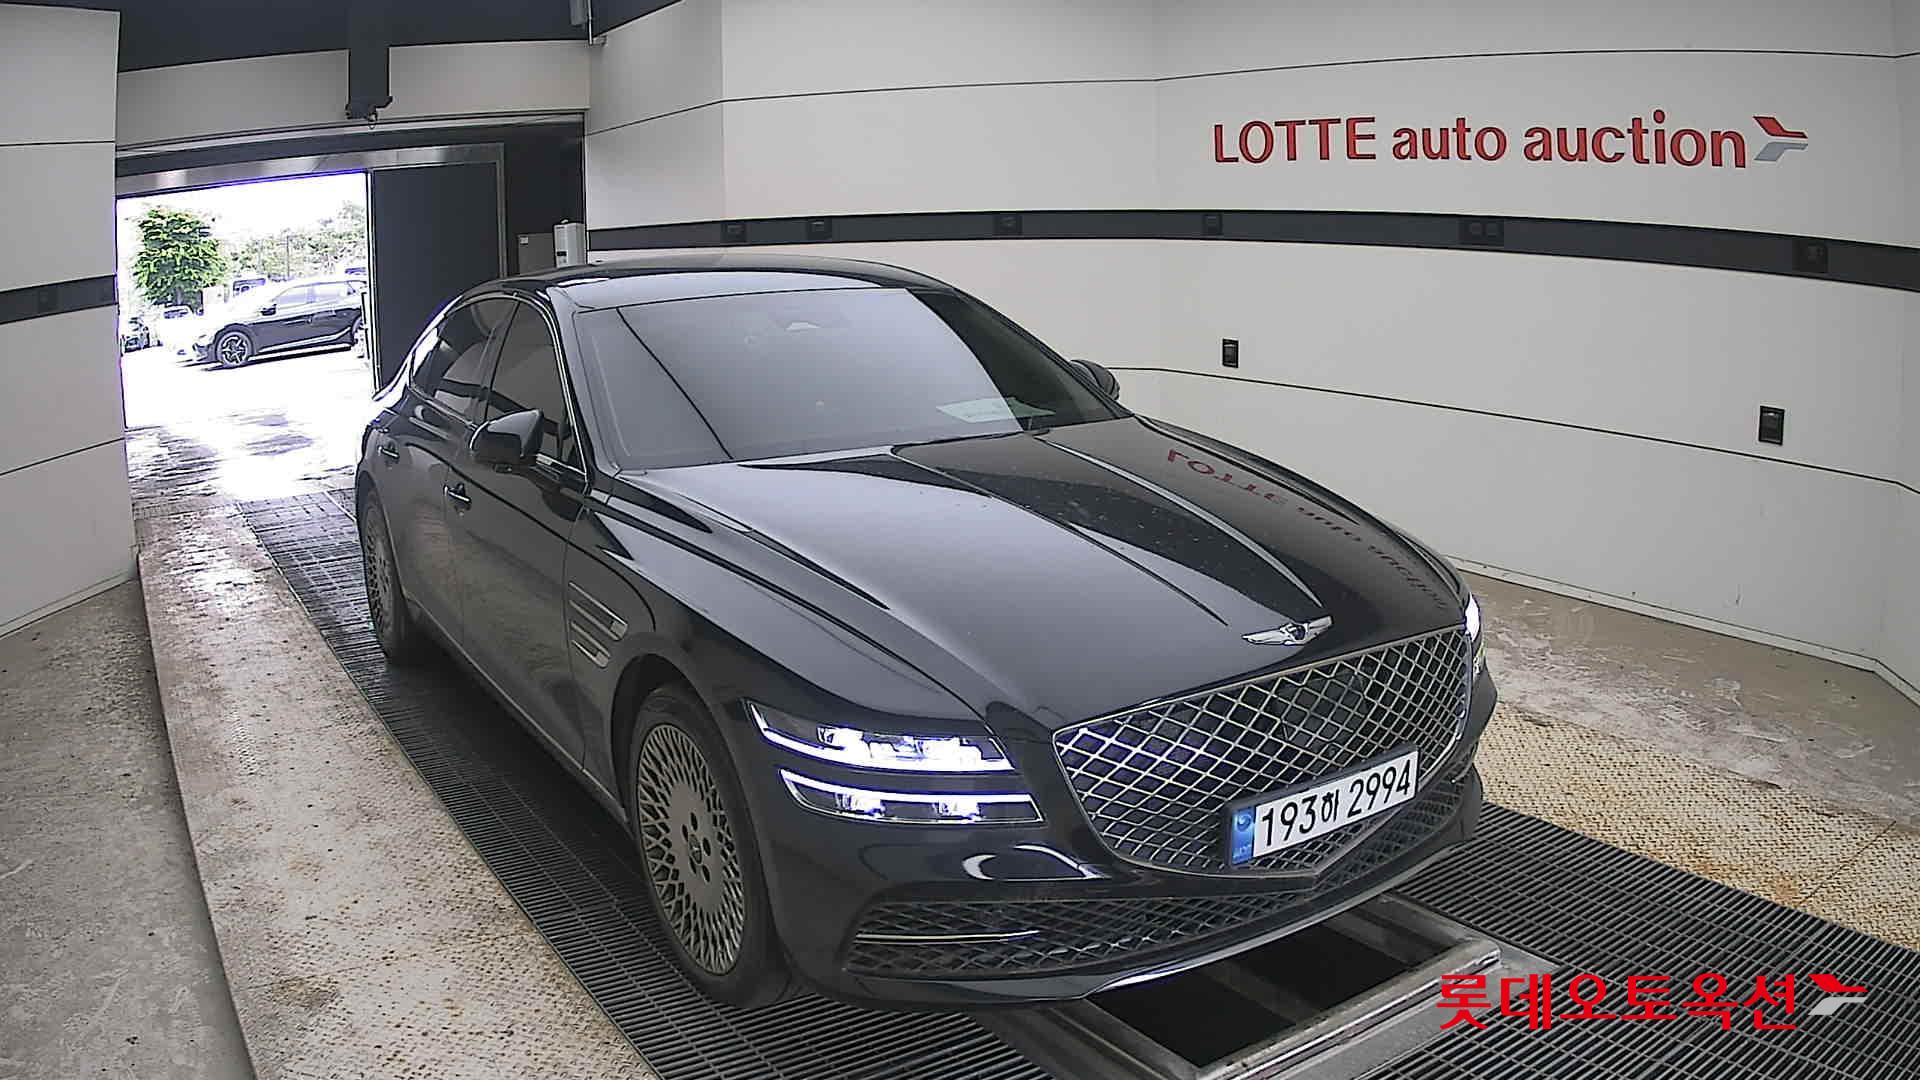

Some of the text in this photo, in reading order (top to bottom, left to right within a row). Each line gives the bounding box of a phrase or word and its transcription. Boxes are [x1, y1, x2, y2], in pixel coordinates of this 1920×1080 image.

[1213, 109, 1746, 168] LOTTE auto auction
[1261, 758, 1411, 847] 193하 2994
